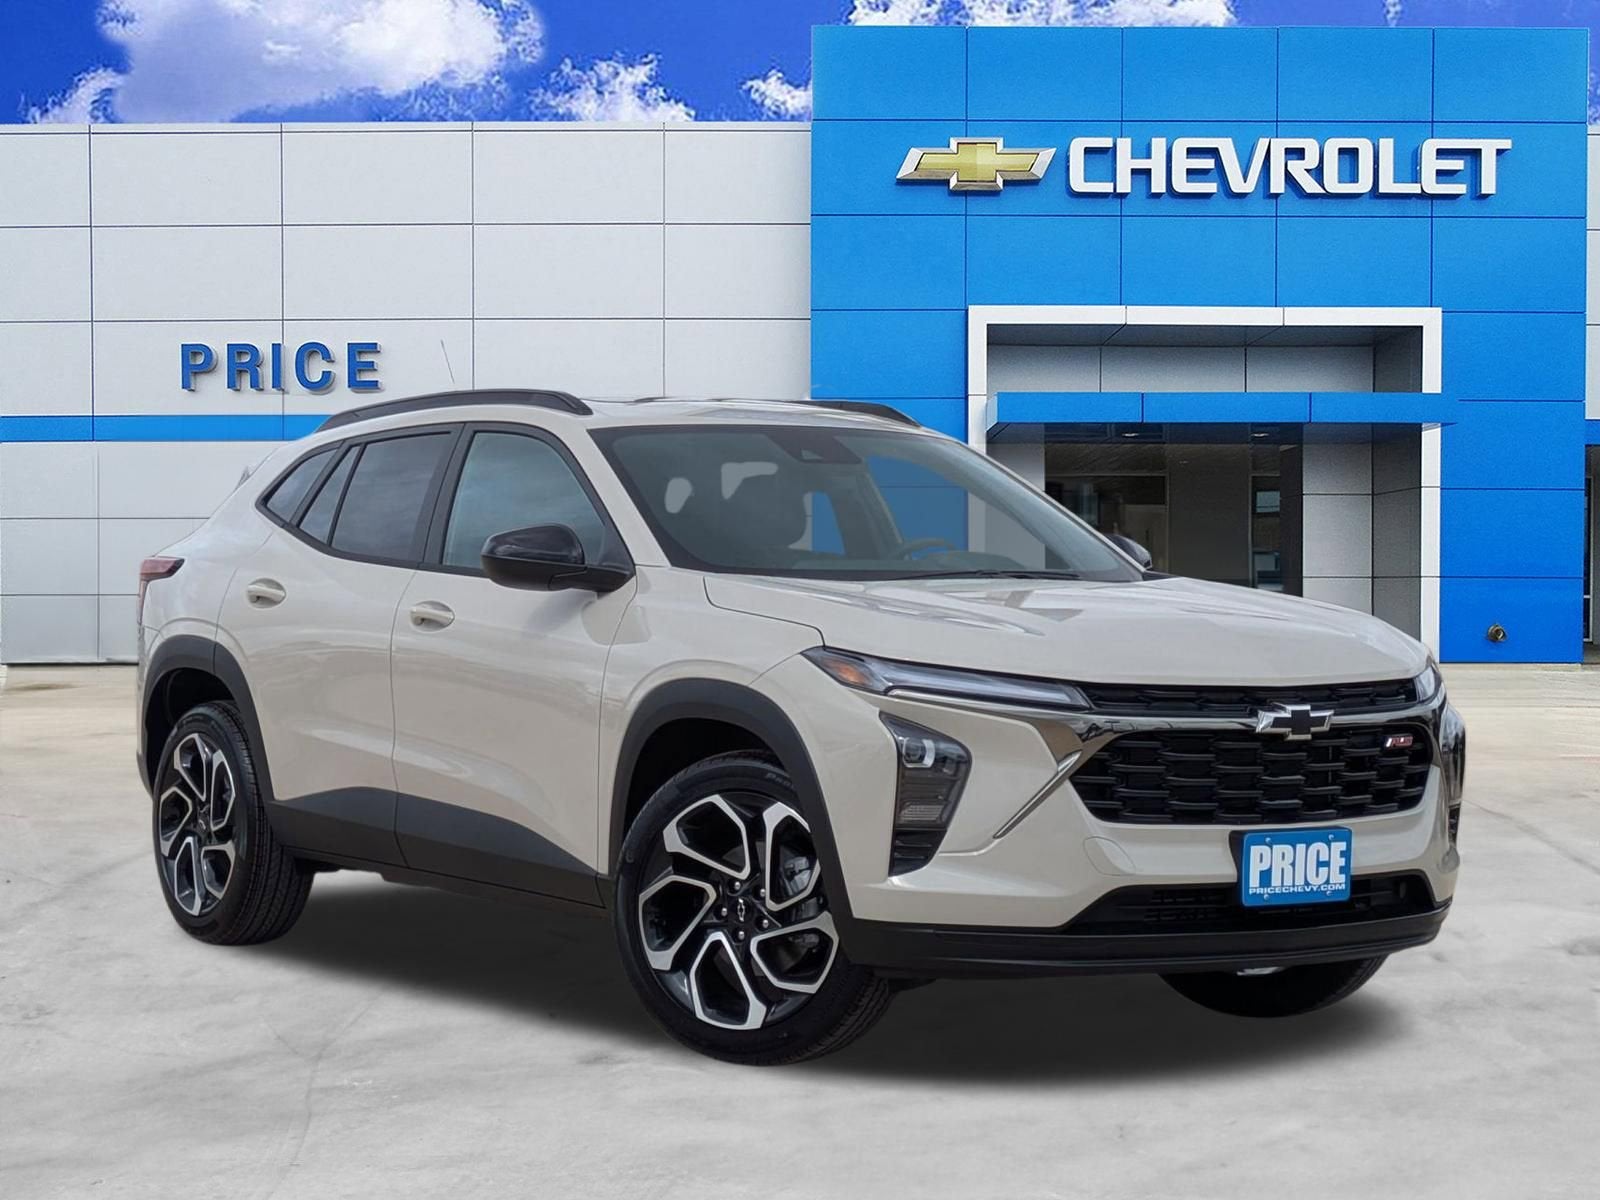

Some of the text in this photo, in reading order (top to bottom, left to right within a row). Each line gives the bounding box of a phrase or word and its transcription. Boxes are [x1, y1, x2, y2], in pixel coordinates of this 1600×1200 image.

[1069, 136, 1512, 196] CHEVROLET
[180, 342, 381, 393] PRICE
[1249, 841, 1347, 887] PRICE
[1249, 883, 1346, 895] PRICECHEVY.COM
